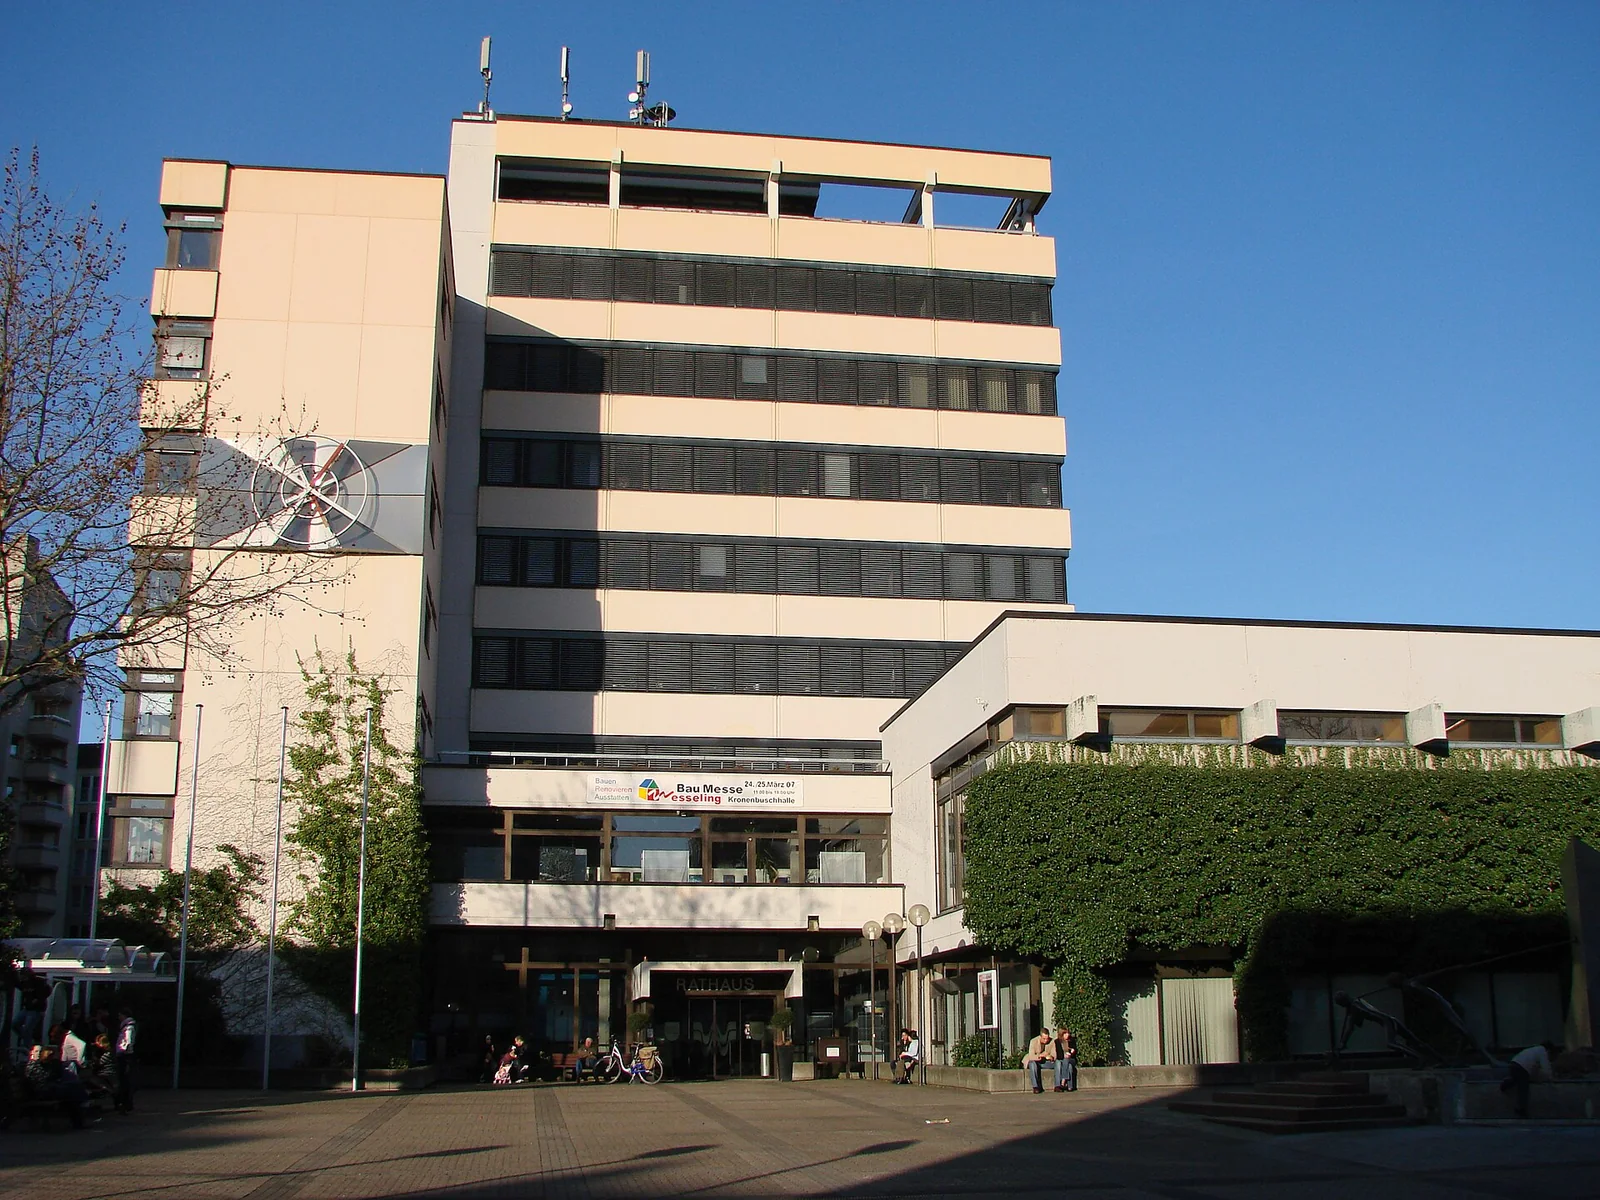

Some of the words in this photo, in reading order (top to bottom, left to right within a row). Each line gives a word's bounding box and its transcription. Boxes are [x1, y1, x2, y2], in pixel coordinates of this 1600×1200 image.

[677, 783, 699, 793] Bau
[703, 784, 743, 794] Messe
[728, 796, 795, 804] Kronenbuschhalle
[676, 977, 755, 991] RATHAUS
